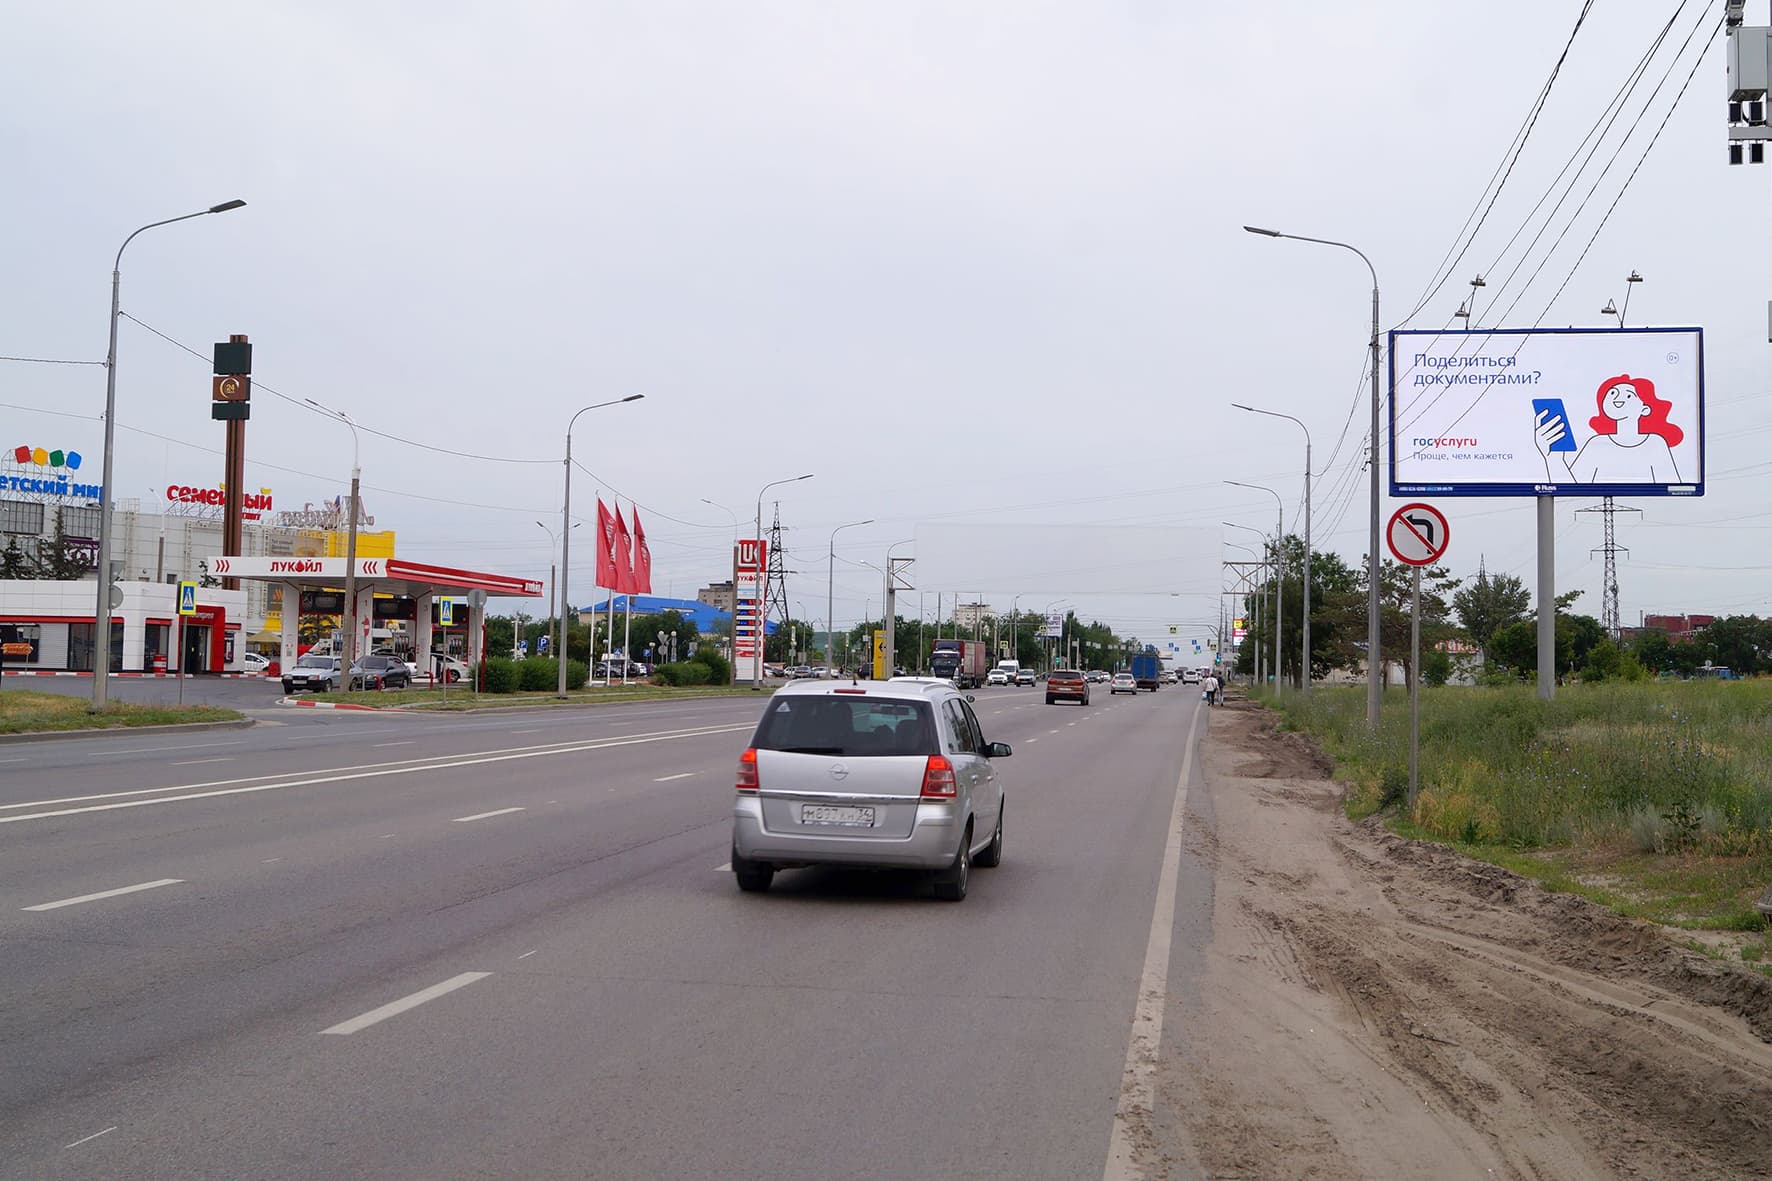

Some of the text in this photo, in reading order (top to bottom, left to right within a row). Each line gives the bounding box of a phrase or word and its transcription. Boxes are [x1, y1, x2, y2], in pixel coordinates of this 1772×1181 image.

[1414, 353, 1516, 369] Поделиться
[1413, 370, 1542, 388] документами?
[1413, 437, 1477, 448] госуслуги
[1413, 451, 1449, 461] Проще,
[270, 559, 323, 573] ЛУКОЙЛ
